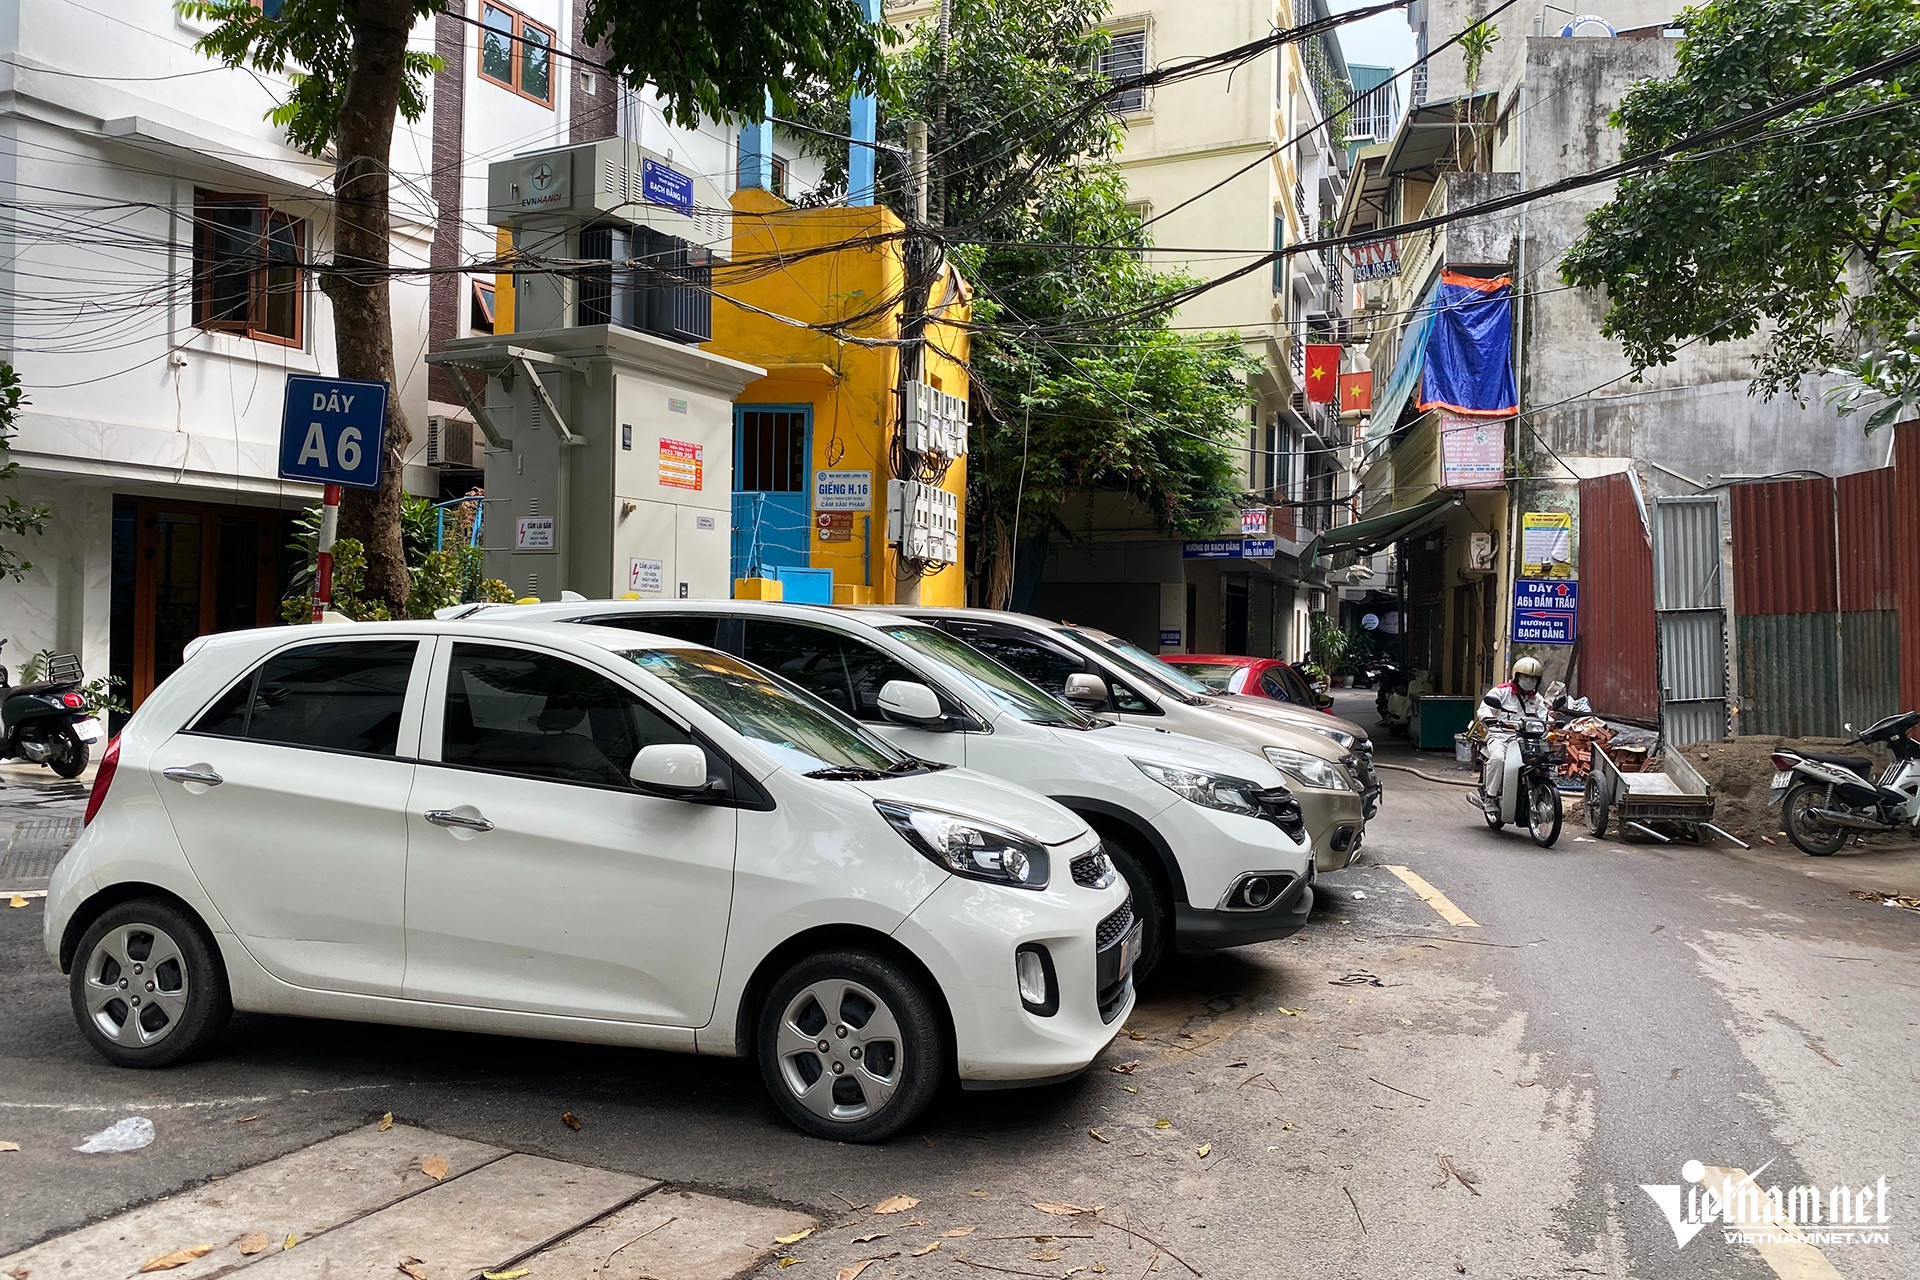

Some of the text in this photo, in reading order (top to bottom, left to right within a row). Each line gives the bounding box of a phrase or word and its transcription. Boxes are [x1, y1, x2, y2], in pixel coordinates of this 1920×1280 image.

[521, 194, 562, 206] EVNHANOI
[650, 182, 665, 194] BẠCH
[682, 196, 687, 204] 11
[1350, 240, 1398, 267] TIVI
[312, 389, 355, 414] DÃY
[298, 422, 362, 471] A6
[819, 480, 868, 494] GIẾNG H.16
[1242, 514, 1266, 525] TIVI
[1186, 543, 1203, 551] HƯỚNG
[1211, 543, 1224, 552] BẠCH
[1528, 583, 1553, 592] DÃY
[1517, 596, 1532, 607] A6b
[1555, 594, 1575, 608] TRẤU
[1518, 628, 1540, 639] BẠCH
